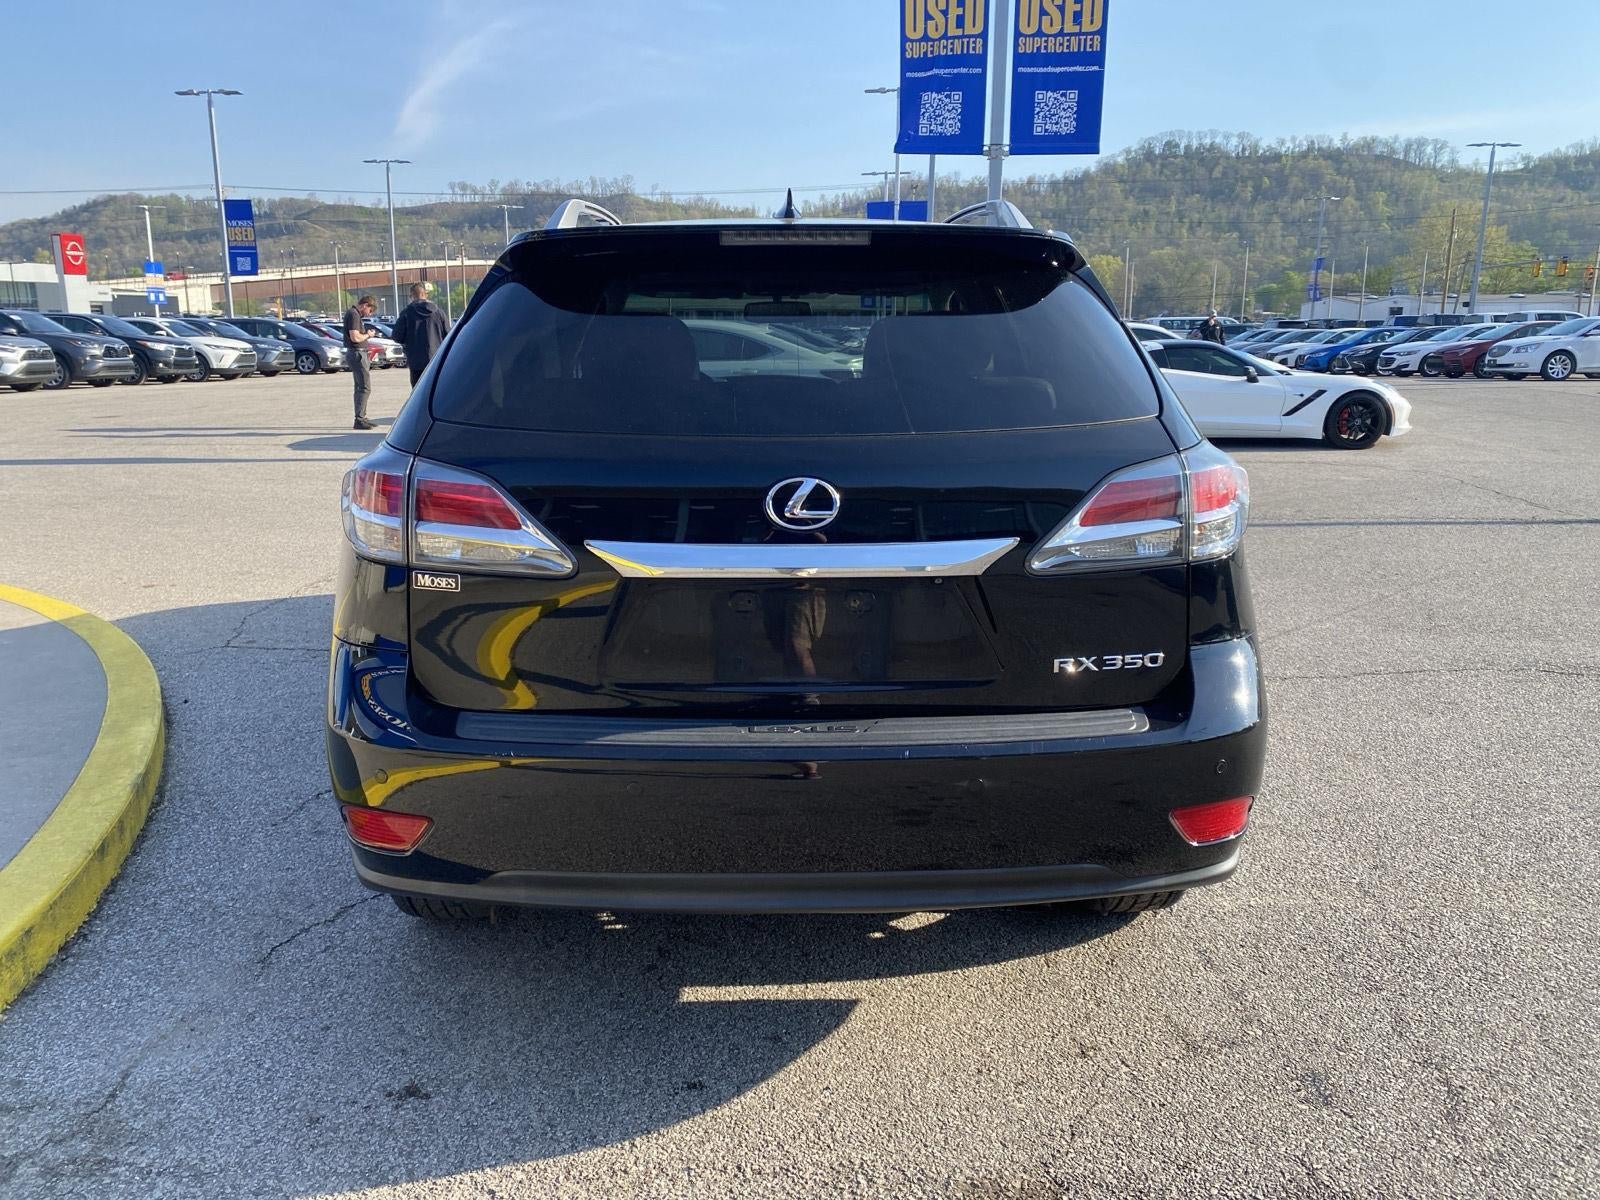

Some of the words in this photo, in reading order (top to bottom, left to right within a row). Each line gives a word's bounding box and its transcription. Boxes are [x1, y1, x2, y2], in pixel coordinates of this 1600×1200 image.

[905, 0, 984, 39] USED
[1019, 0, 1103, 34] USED
[905, 38, 983, 59] SUPERCENTER
[1018, 35, 1101, 53] SUPERCENTER
[227, 227, 255, 241] USED
[747, 725, 859, 734] LEXUS
